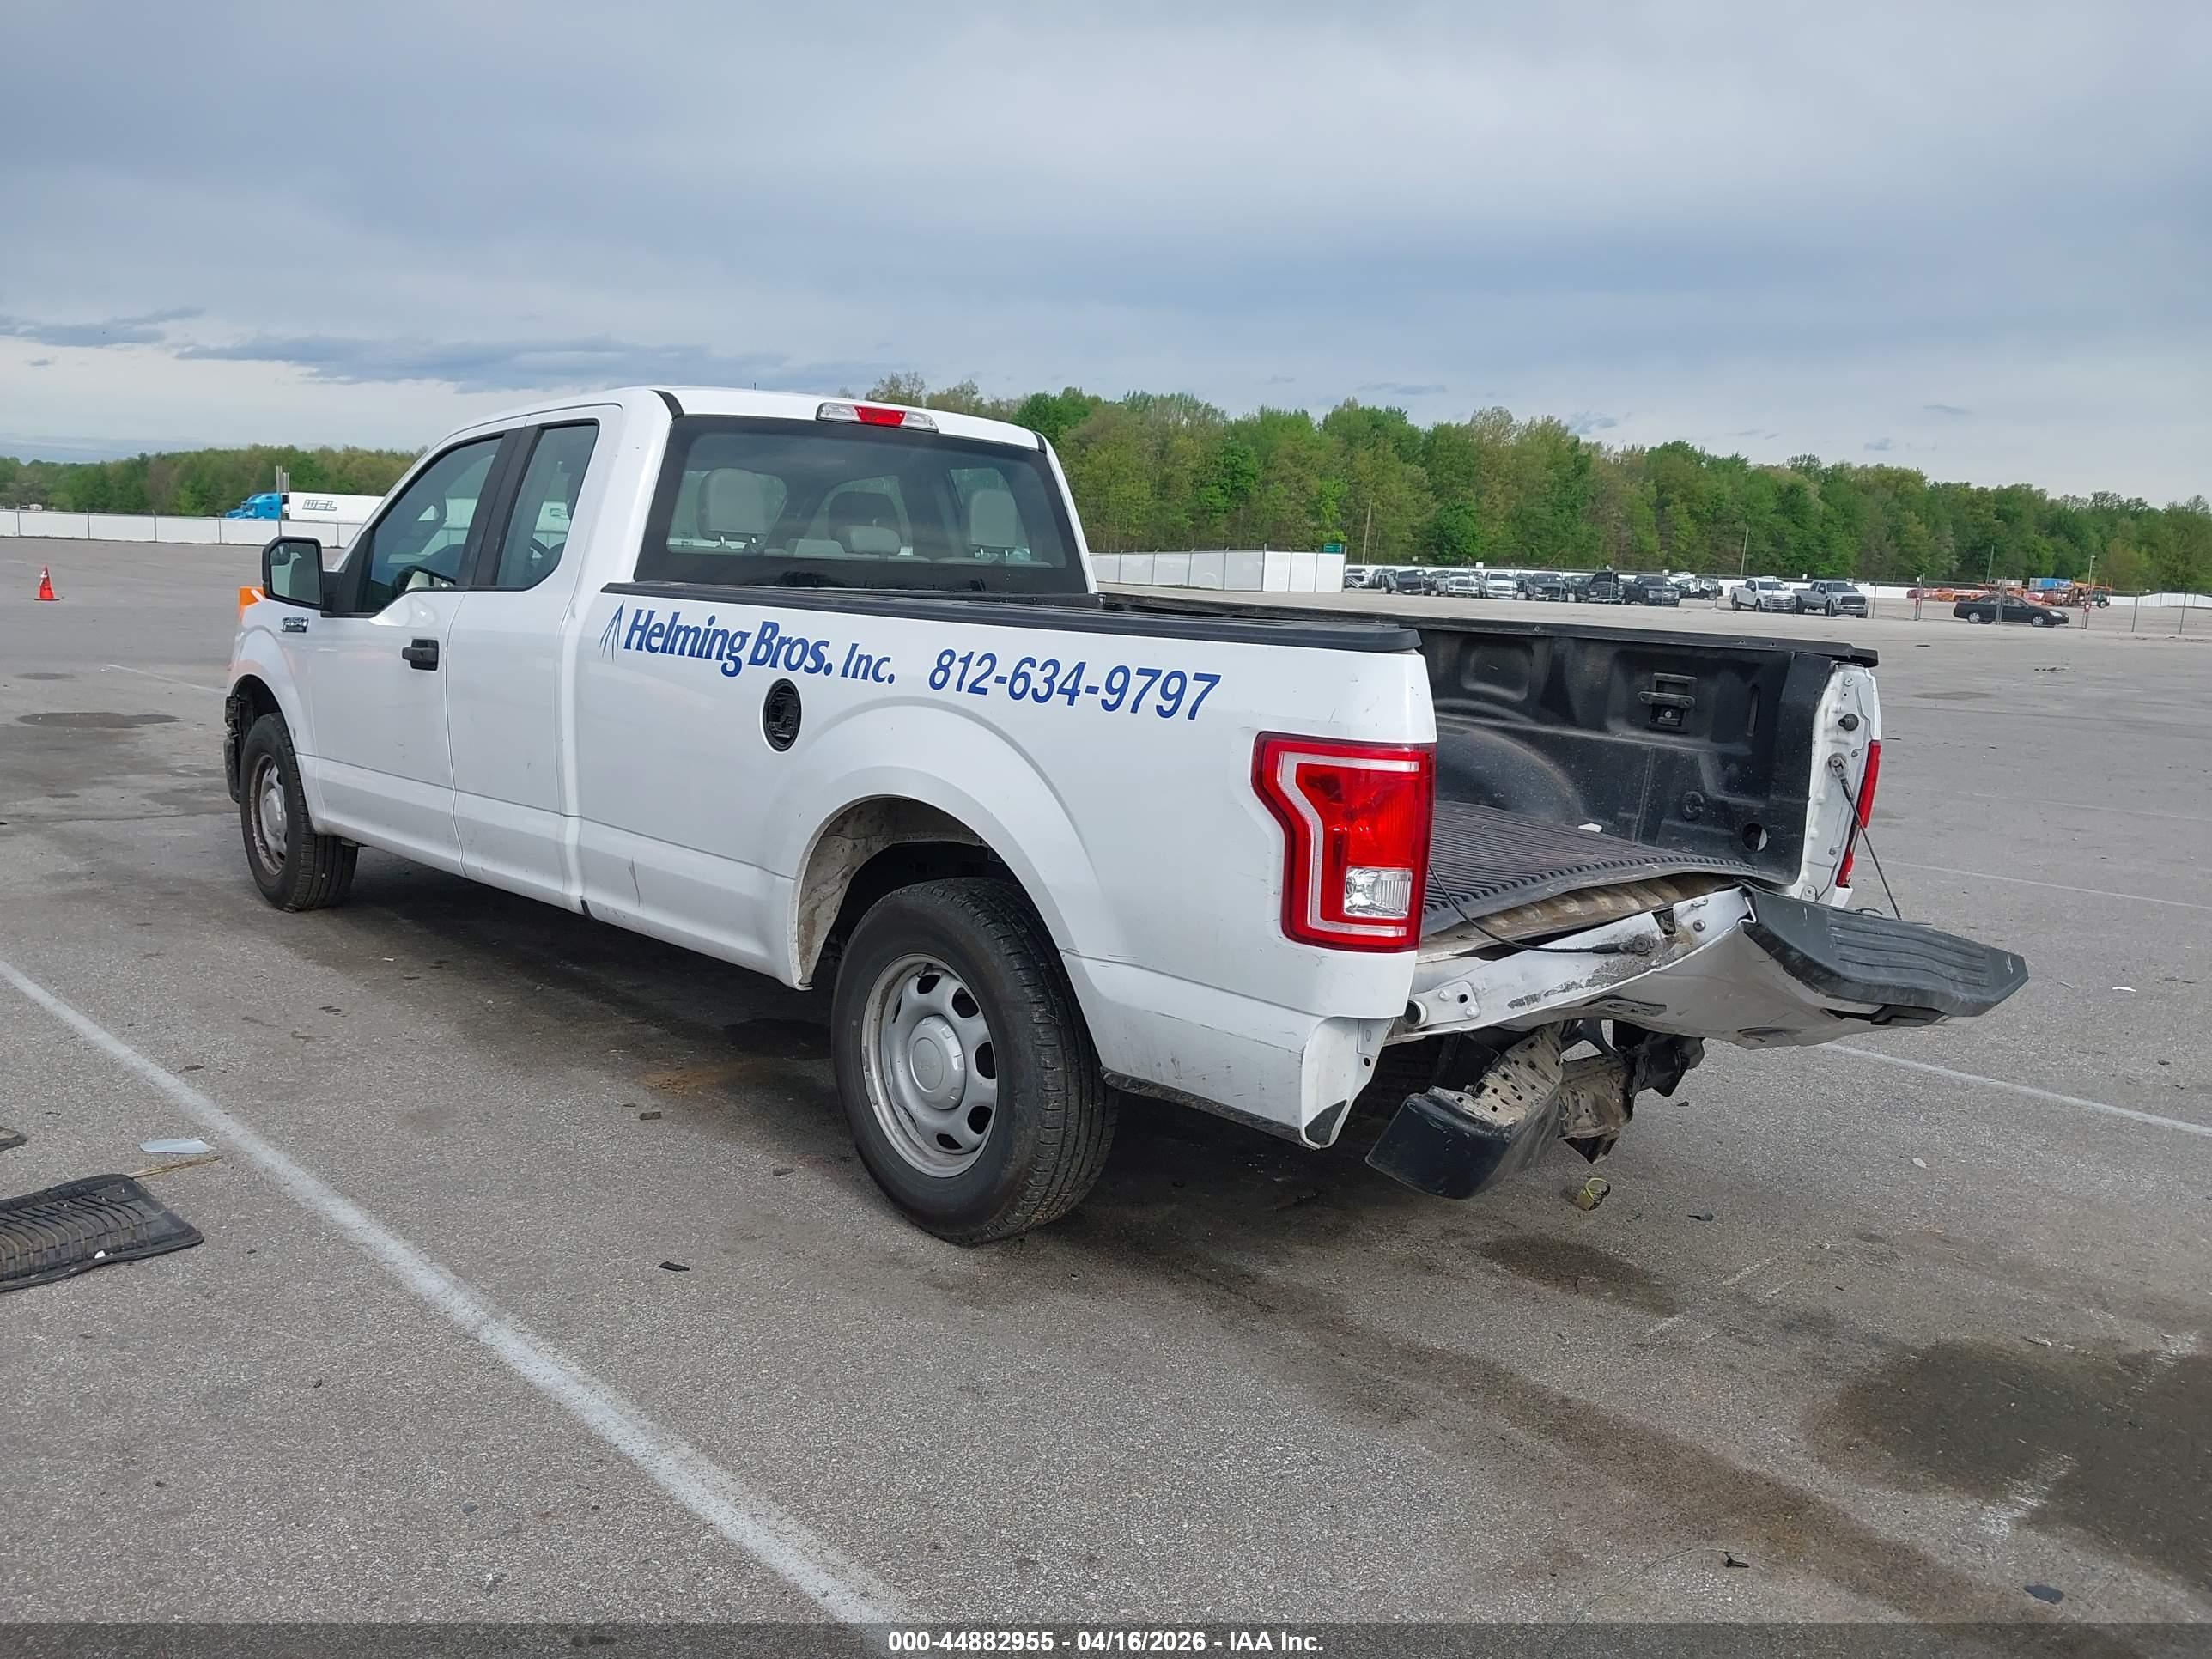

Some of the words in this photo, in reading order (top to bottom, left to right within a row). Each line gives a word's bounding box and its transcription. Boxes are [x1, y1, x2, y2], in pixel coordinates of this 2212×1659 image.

[301, 499, 337, 512] WEL
[623, 609, 751, 678] Helming
[747, 621, 834, 677] Bros.
[840, 642, 894, 684] Inc.
[928, 647, 1221, 720] 812-634-9797
